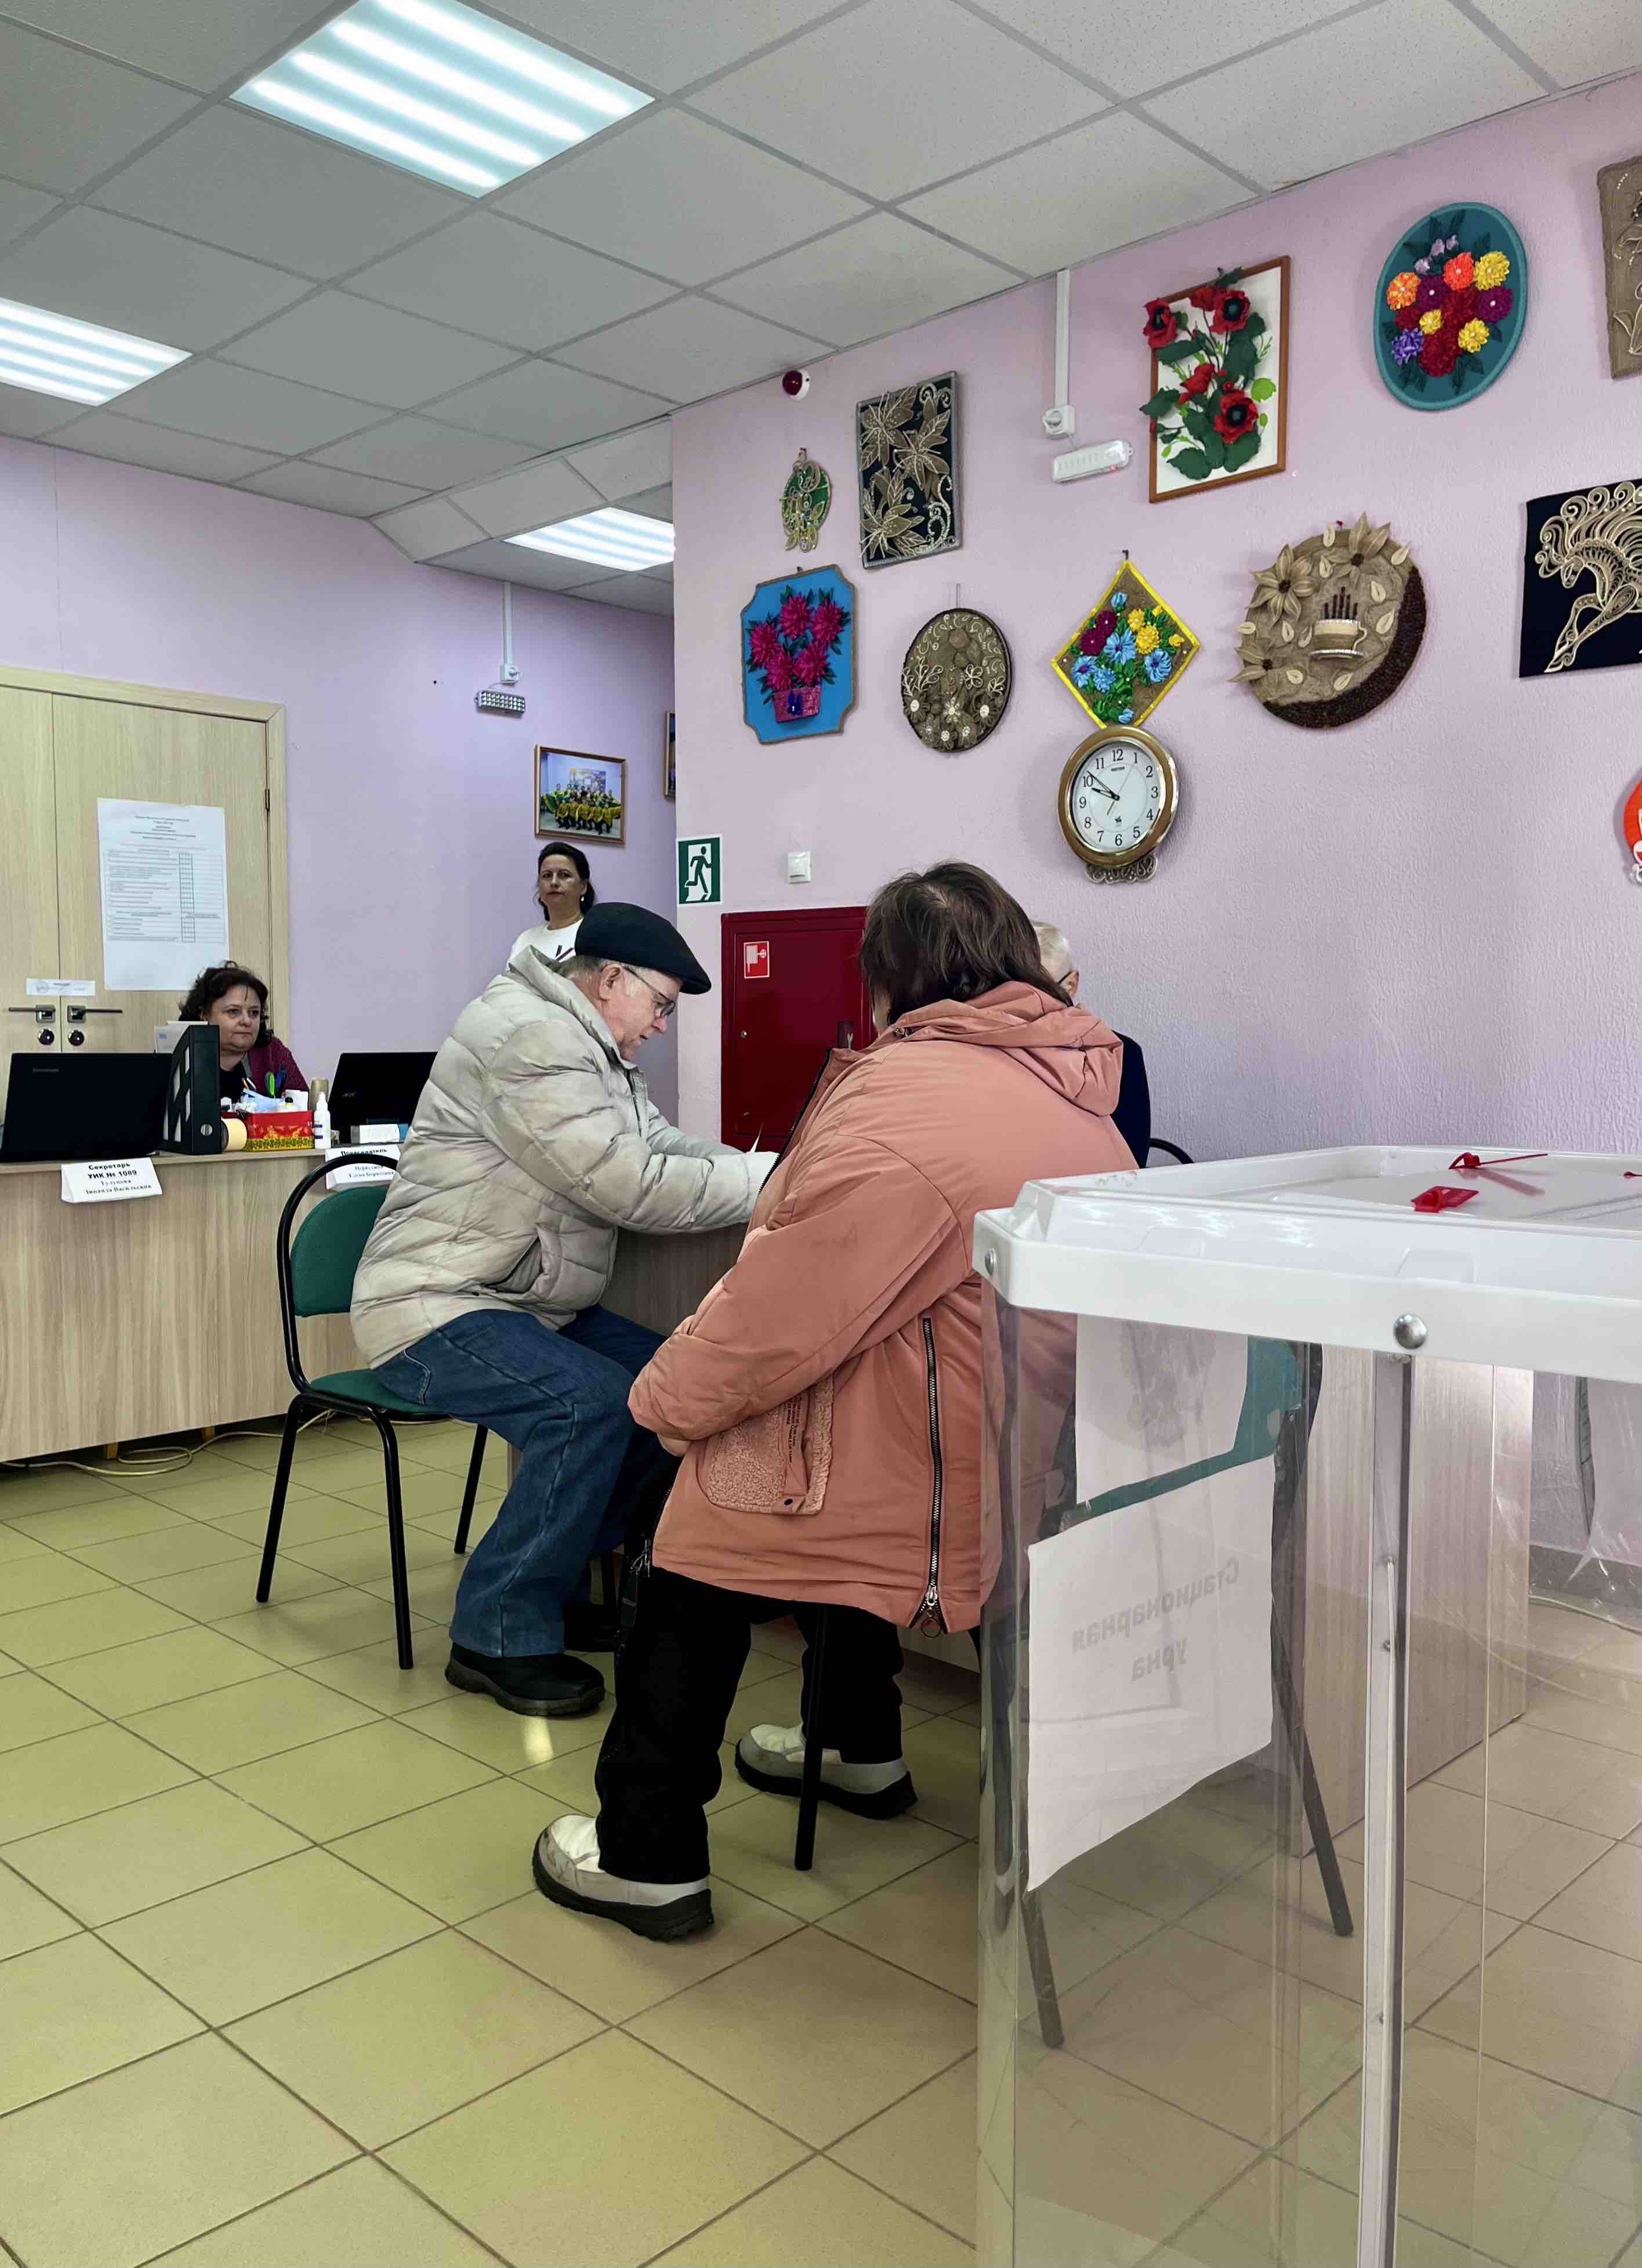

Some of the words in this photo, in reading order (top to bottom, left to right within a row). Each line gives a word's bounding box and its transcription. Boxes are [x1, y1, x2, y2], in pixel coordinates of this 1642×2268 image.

[1112, 749, 1123, 761] 12
[1133, 752, 1137, 764] 1
[1096, 757, 1105, 770] 11
[1146, 765, 1154, 778] 2
[1083, 775, 1093, 788] 10
[1151, 786, 1159, 799] 3
[1079, 796, 1086, 808] 9
[1146, 808, 1154, 821] 4
[1084, 817, 1092, 829] 8
[1097, 830, 1104, 842] 7
[1133, 826, 1141, 839] 5
[1114, 834, 1123, 846] 6
